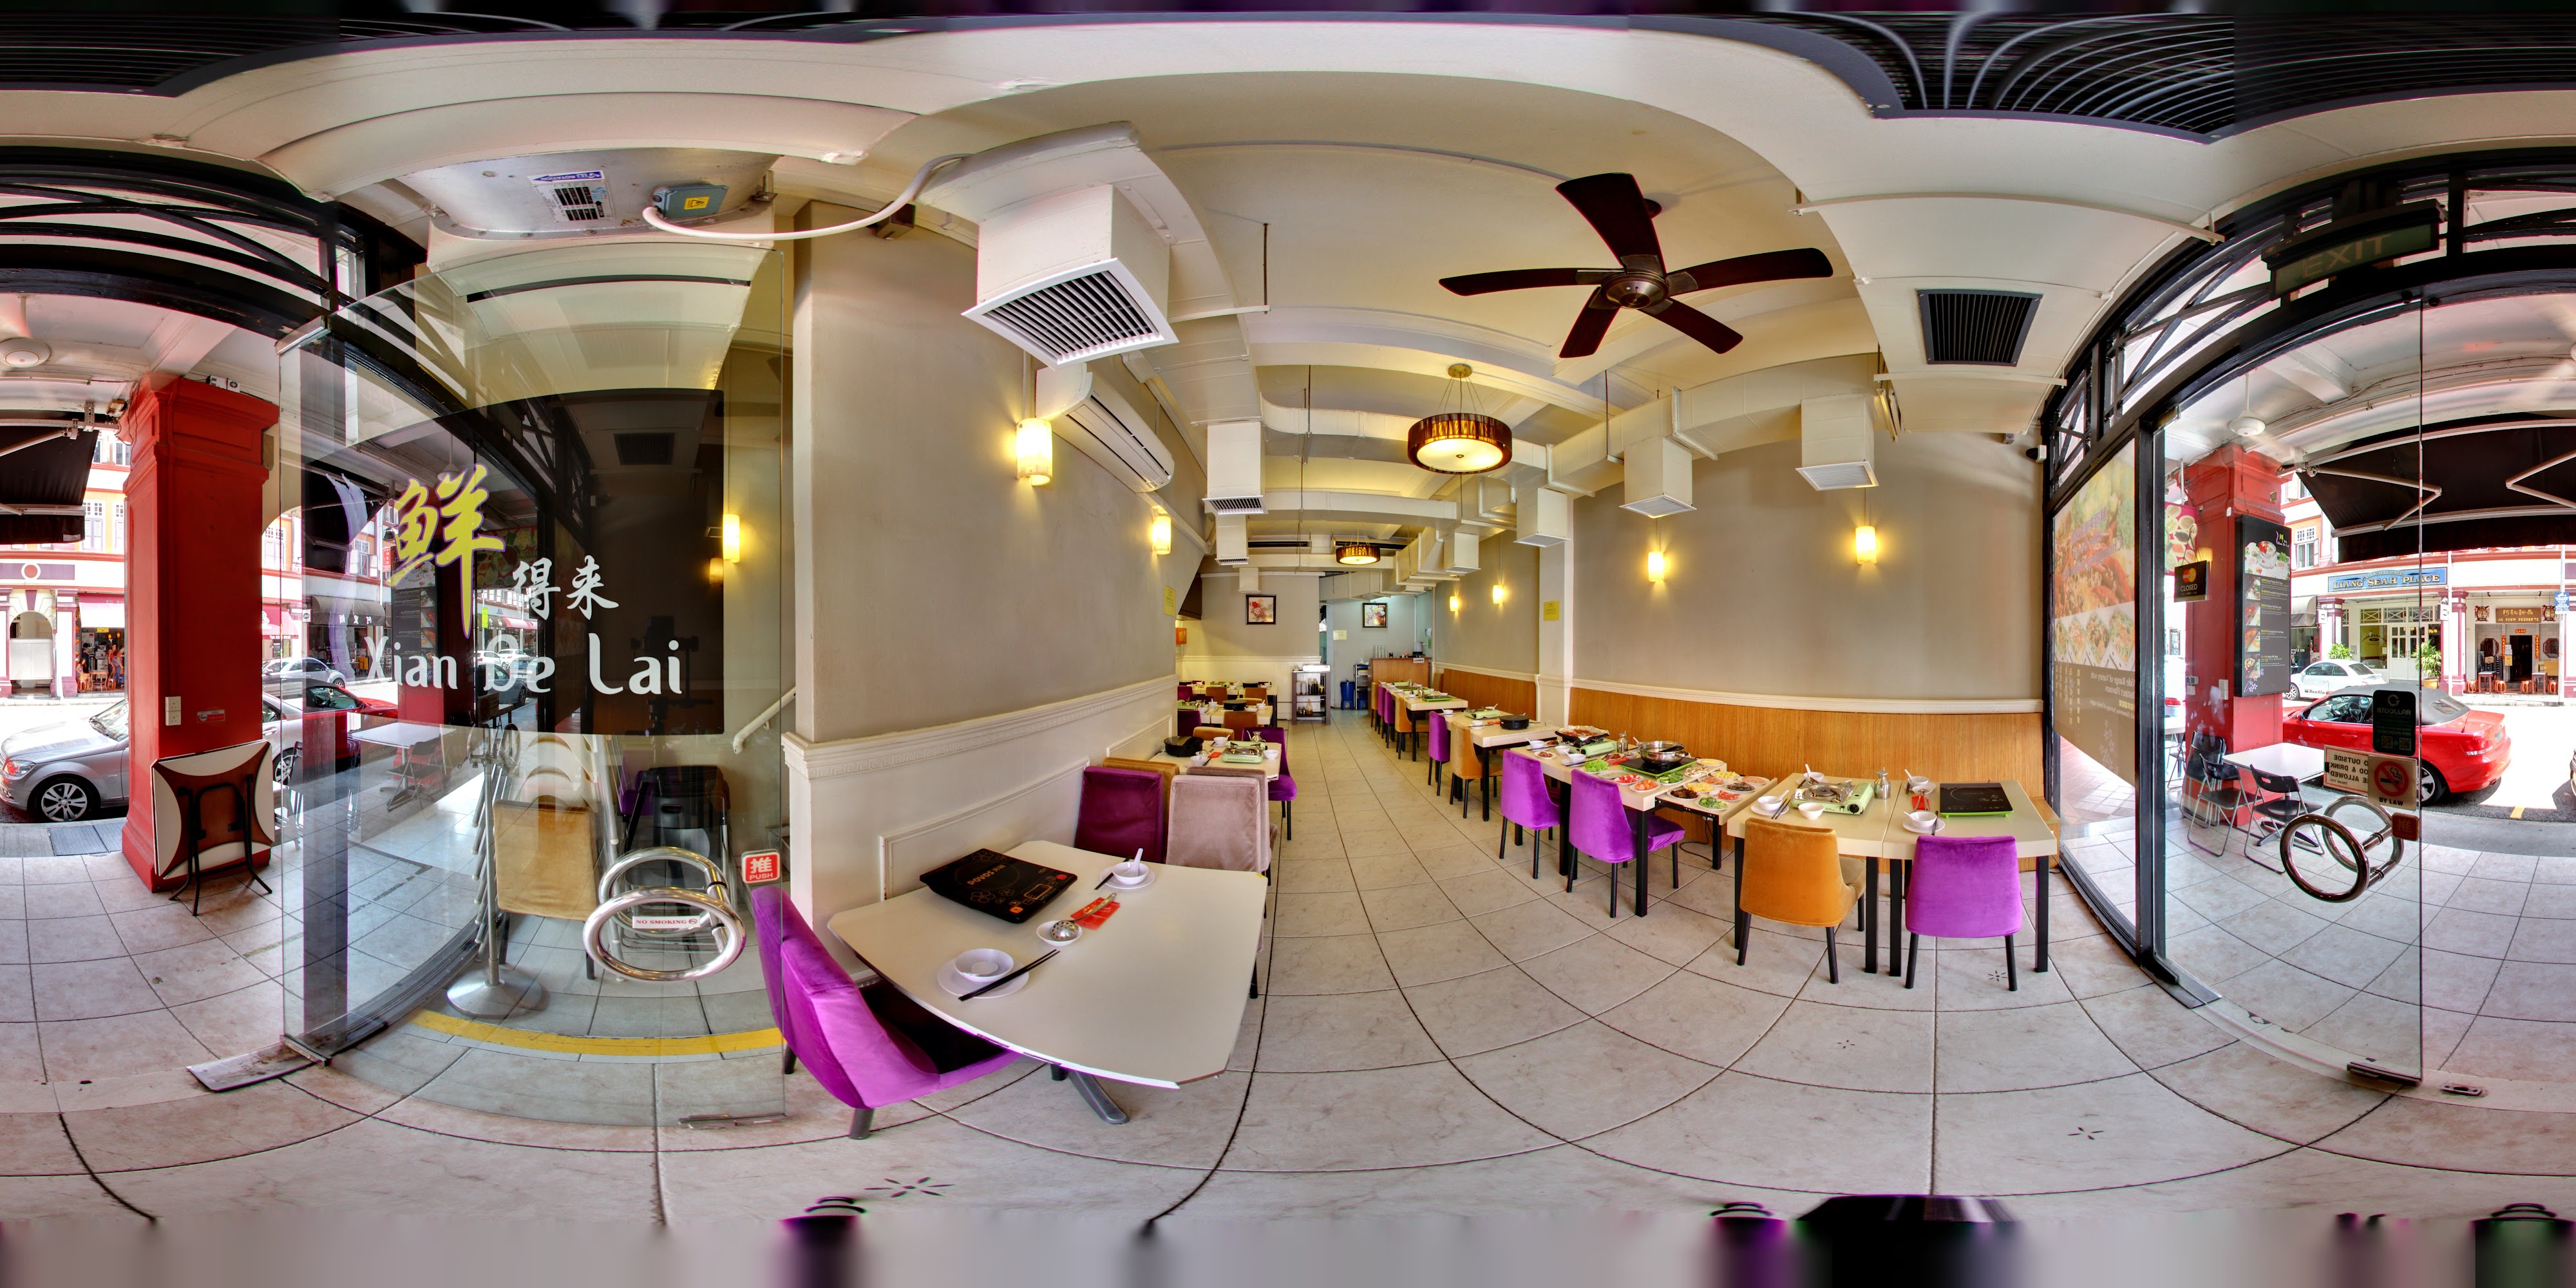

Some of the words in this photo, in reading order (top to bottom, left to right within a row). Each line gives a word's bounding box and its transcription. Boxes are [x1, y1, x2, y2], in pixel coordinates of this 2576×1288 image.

[2303, 233, 2391, 279] EXIT
[2333, 580, 2363, 589] LIANG
[2368, 576, 2397, 585] SEAH
[2402, 574, 2440, 583] PLACE
[365, 635, 459, 690] Xian
[588, 633, 683, 696] Lai
[750, 857, 773, 874] 推
